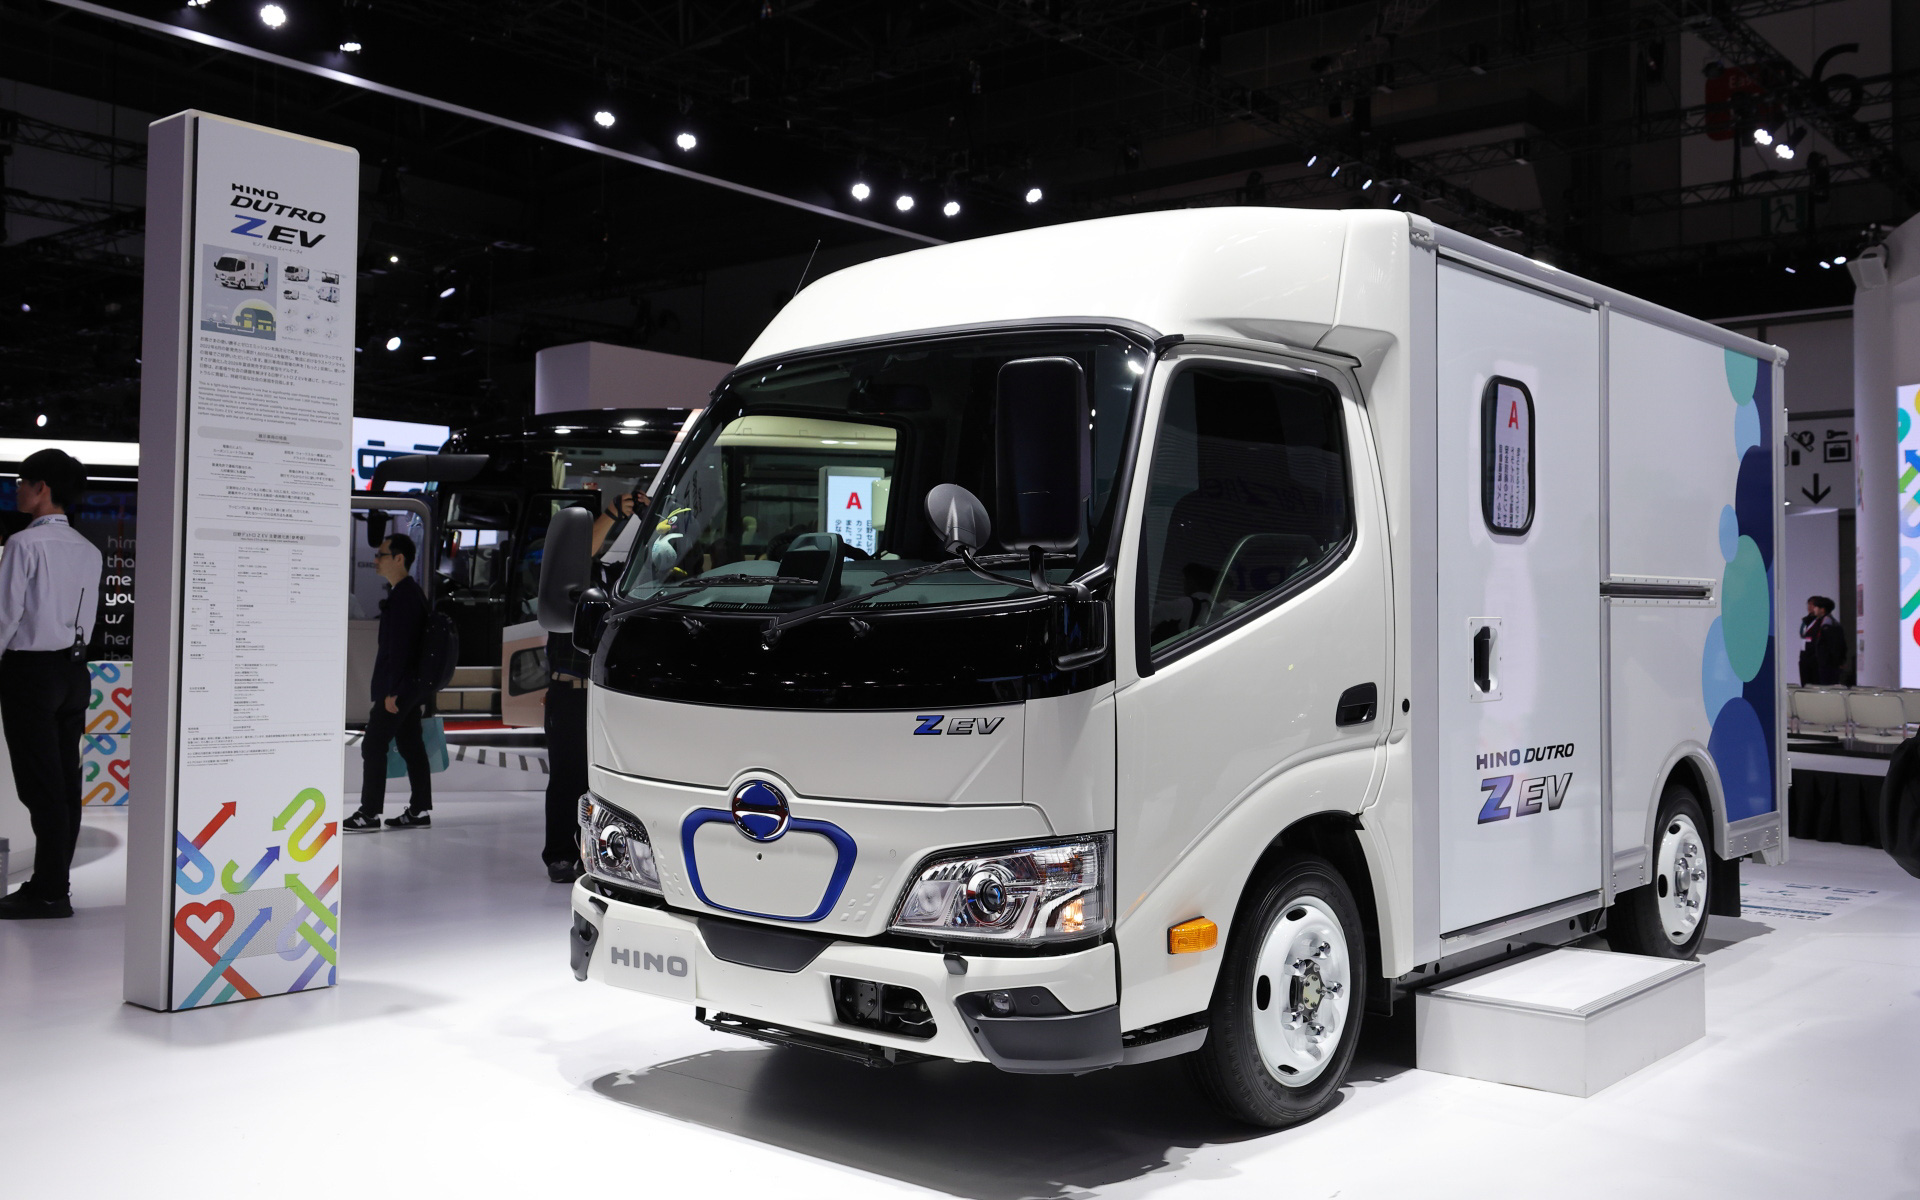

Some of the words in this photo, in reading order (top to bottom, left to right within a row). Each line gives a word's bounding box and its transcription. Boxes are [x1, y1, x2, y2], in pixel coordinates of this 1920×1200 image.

[1812, 43, 1862, 116] 6
[232, 183, 278, 200] HINO
[230, 195, 326, 223] DUTRO
[230, 214, 267, 238] Z
[268, 225, 326, 248] EV
[846, 492, 862, 509] A
[106, 575, 132, 586] me
[105, 614, 125, 624] us
[104, 632, 131, 645] her
[913, 715, 944, 735] Z
[947, 717, 1005, 735] EV
[1476, 749, 1520, 770] HINO
[1524, 743, 1574, 764] DUTRO
[1478, 775, 1514, 825] Z
[1516, 772, 1573, 817] EV
[611, 946, 687, 977] HINO
